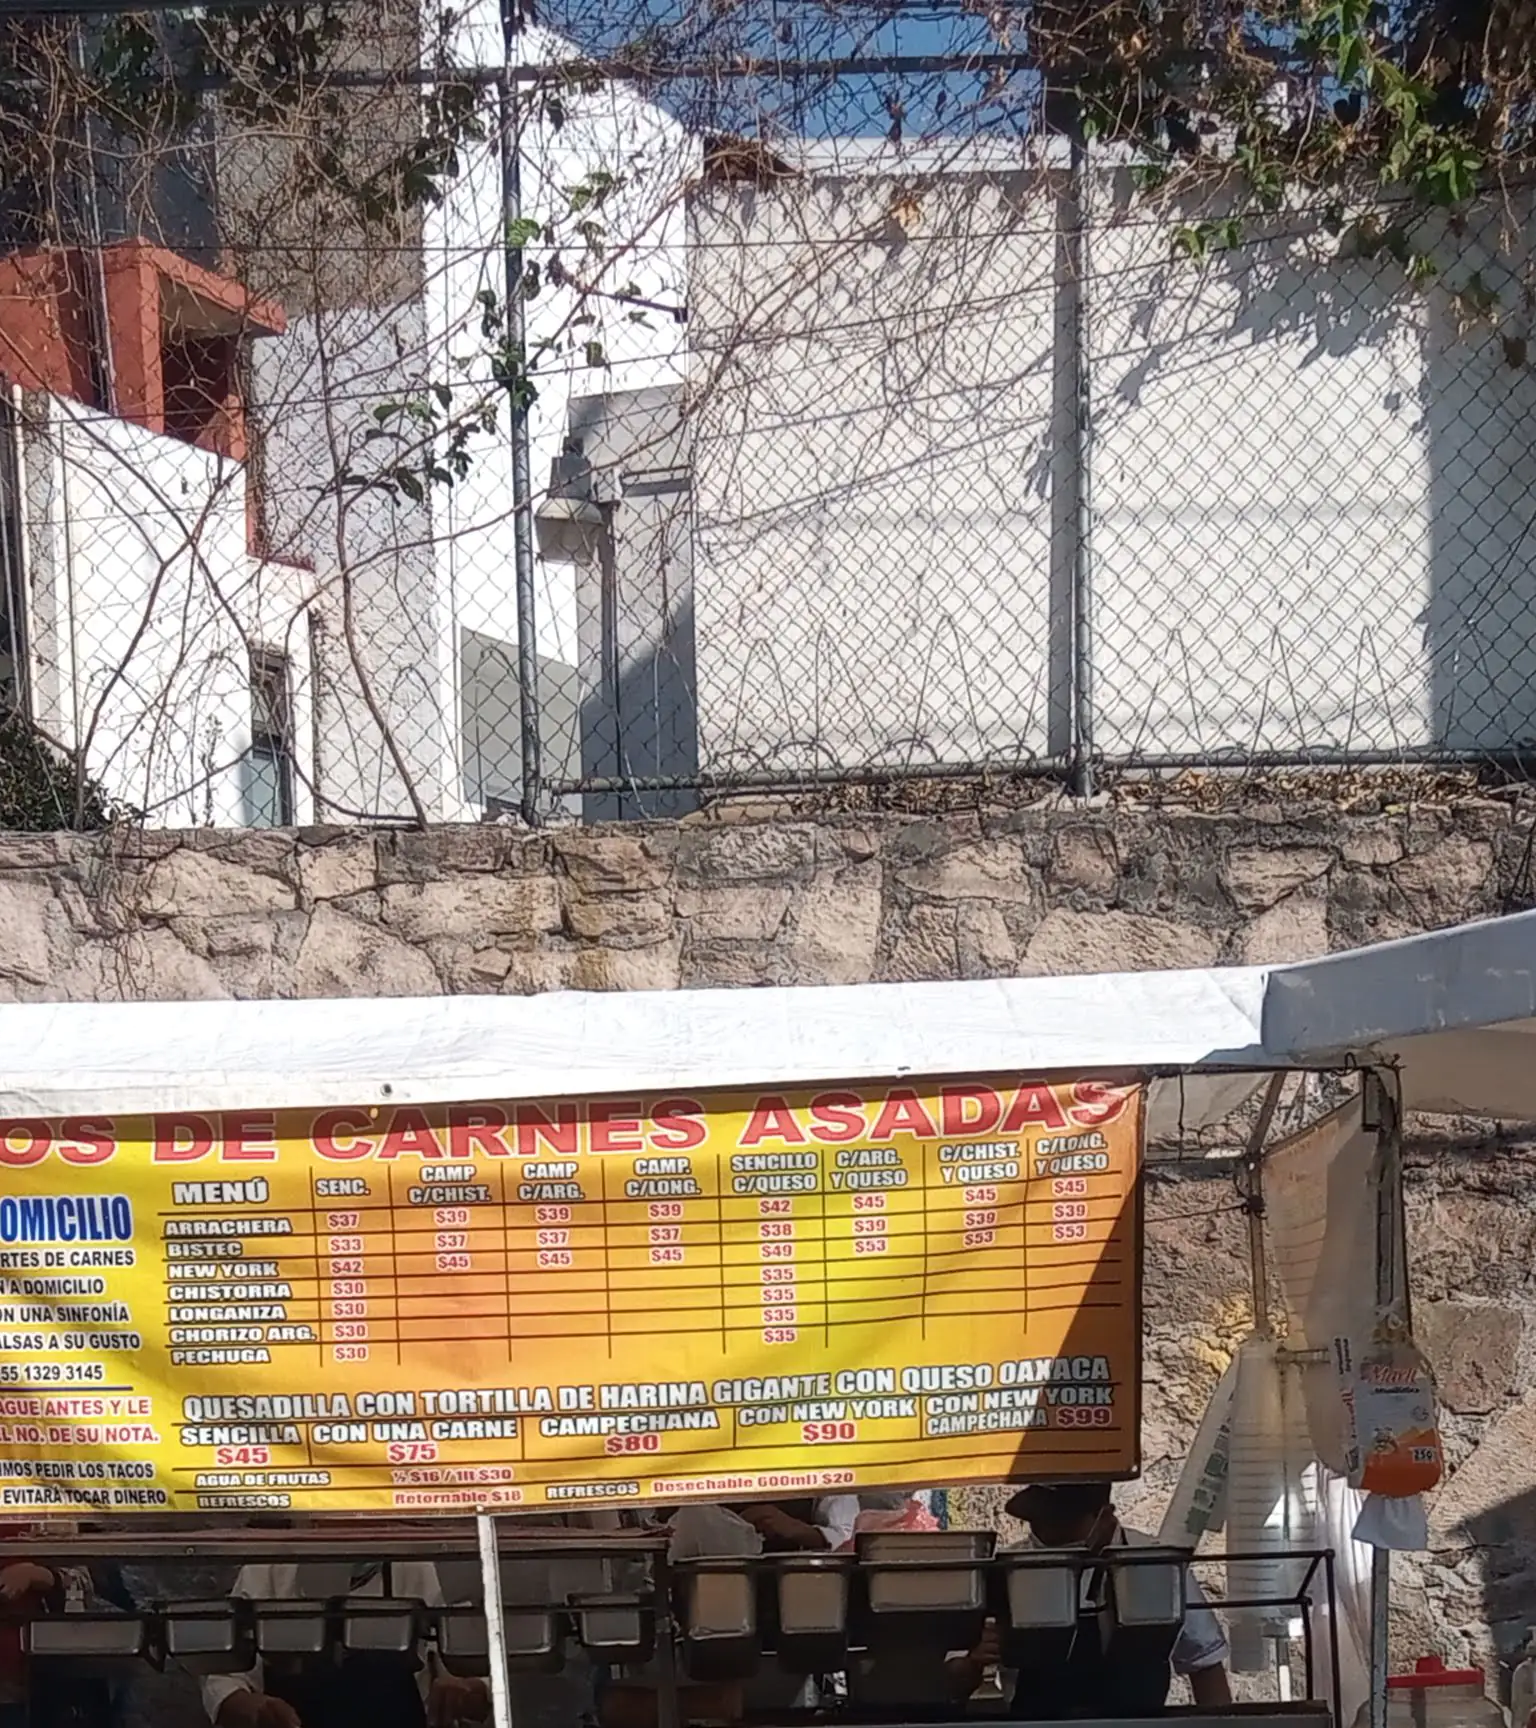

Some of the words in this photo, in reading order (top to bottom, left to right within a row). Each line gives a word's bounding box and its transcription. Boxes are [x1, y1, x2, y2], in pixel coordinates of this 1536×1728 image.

[152, 1109, 276, 1161] DE
[311, 1096, 707, 1160] CARNES
[739, 1077, 1130, 1147] ASADAS
[836, 1149, 901, 1169] C/ARG.
[939, 1141, 1021, 1163] C/CHIST.
[1035, 1132, 1107, 1155] C/LONG.
[173, 1177, 269, 1205] MENÚ
[316, 1178, 371, 1197] SENC.
[420, 1165, 477, 1183] CAMP
[522, 1162, 578, 1180] CAMP
[634, 1157, 692, 1176] CAMP.
[731, 1152, 818, 1171] SENCILLO
[846, 1169, 908, 1189] QUESO
[956, 1162, 1019, 1182] QUESO
[1048, 1153, 1109, 1175] QUESO
[409, 1185, 492, 1205] C/CHIST.
[517, 1183, 585, 1201] C/ARG.
[625, 1178, 702, 1197] C/LONG.
[732, 1173, 818, 1193] C/QUESO
[165, 1218, 292, 1237] ARRACHERA
[328, 1212, 359, 1228] $37
[435, 1208, 467, 1224] $39
[759, 1199, 791, 1214] $42
[853, 1195, 885, 1209] $45
[965, 1189, 996, 1203] $45
[167, 1242, 242, 1258] BISTEC
[330, 1237, 362, 1253] $33
[436, 1233, 466, 1248] $37
[760, 1223, 792, 1238] $38
[853, 1218, 886, 1233] $39
[965, 1211, 996, 1227] $39
[45, 1250, 65, 1267] DE
[70, 1249, 134, 1266] CARNES
[168, 1262, 214, 1280] NEW
[217, 1261, 280, 1279] YORK
[331, 1260, 362, 1275] $42
[437, 1254, 469, 1270] $45
[761, 1243, 793, 1258] $49
[854, 1239, 886, 1254] $53
[965, 1231, 994, 1246] $53
[24, 1278, 105, 1295] DOMICILIO
[168, 1282, 292, 1299] CHISTORRA
[333, 1281, 364, 1296] $30
[761, 1268, 794, 1282] $35
[20, 1305, 54, 1323] UNA
[56, 1300, 130, 1322] SINFONÍA
[169, 1304, 287, 1322] LONGANIZA
[334, 1302, 365, 1317] $30
[64, 1333, 85, 1349] SU
[91, 1333, 141, 1349] GUSTO
[170, 1326, 263, 1344] CHORIZO
[266, 1325, 317, 1342] ARG.
[171, 1348, 270, 1366] PECHUGA
[0, 1365, 19, 1381] 55
[24, 1365, 61, 1381] 1329
[65, 1364, 104, 1381] 3145
[182, 1394, 352, 1423] QUESADILLA
[355, 1391, 415, 1417] CON
[418, 1387, 553, 1415] TORTILLA
[557, 1385, 595, 1412] DE
[599, 1381, 708, 1410] HARINA
[713, 1374, 831, 1404] GIGANTE
[835, 1369, 895, 1395] CON
[901, 1364, 993, 1395] QUESO
[998, 1356, 1111, 1385] OAXACA
[44, 1399, 104, 1416] ANTES
[128, 1398, 150, 1415] LE
[180, 1425, 302, 1446] SENCILLA
[313, 1422, 368, 1443] CON
[372, 1421, 427, 1442] UNA
[431, 1419, 518, 1440] CARNE
[539, 1410, 720, 1437] CAMPECHANA
[738, 1406, 788, 1427] CON
[792, 1402, 845, 1421] NEW
[851, 1398, 917, 1418] YORK
[925, 1394, 980, 1416] CON
[982, 1388, 1040, 1410] NEW
[1045, 1385, 1113, 1405] YORK
[15, 1427, 46, 1443] NO.
[49, 1427, 72, 1444] DE
[75, 1427, 100, 1443] SU
[104, 1426, 160, 1443] NOTA.
[217, 1447, 269, 1465] $45
[388, 1443, 437, 1463] $75
[605, 1434, 659, 1455] $80
[801, 1421, 855, 1441] $90
[926, 1407, 1048, 1436] CAMPECHANA
[1056, 1409, 1112, 1426] $99
[35, 1461, 75, 1479] PEDIR
[78, 1461, 104, 1478] LOS
[108, 1461, 154, 1478] TACOS
[195, 1473, 240, 1487] AGUA
[243, 1473, 265, 1486] DE
[267, 1472, 331, 1485] FRUTAS
[478, 1469, 512, 1480] $30
[3, 1485, 62, 1505] EVITARÁ
[65, 1489, 110, 1506] TOCAR
[113, 1489, 167, 1506] DINERO
[197, 1494, 291, 1509] REFRESCOS
[545, 1482, 640, 1499] REFRESCOS
[821, 1472, 855, 1485] $20
